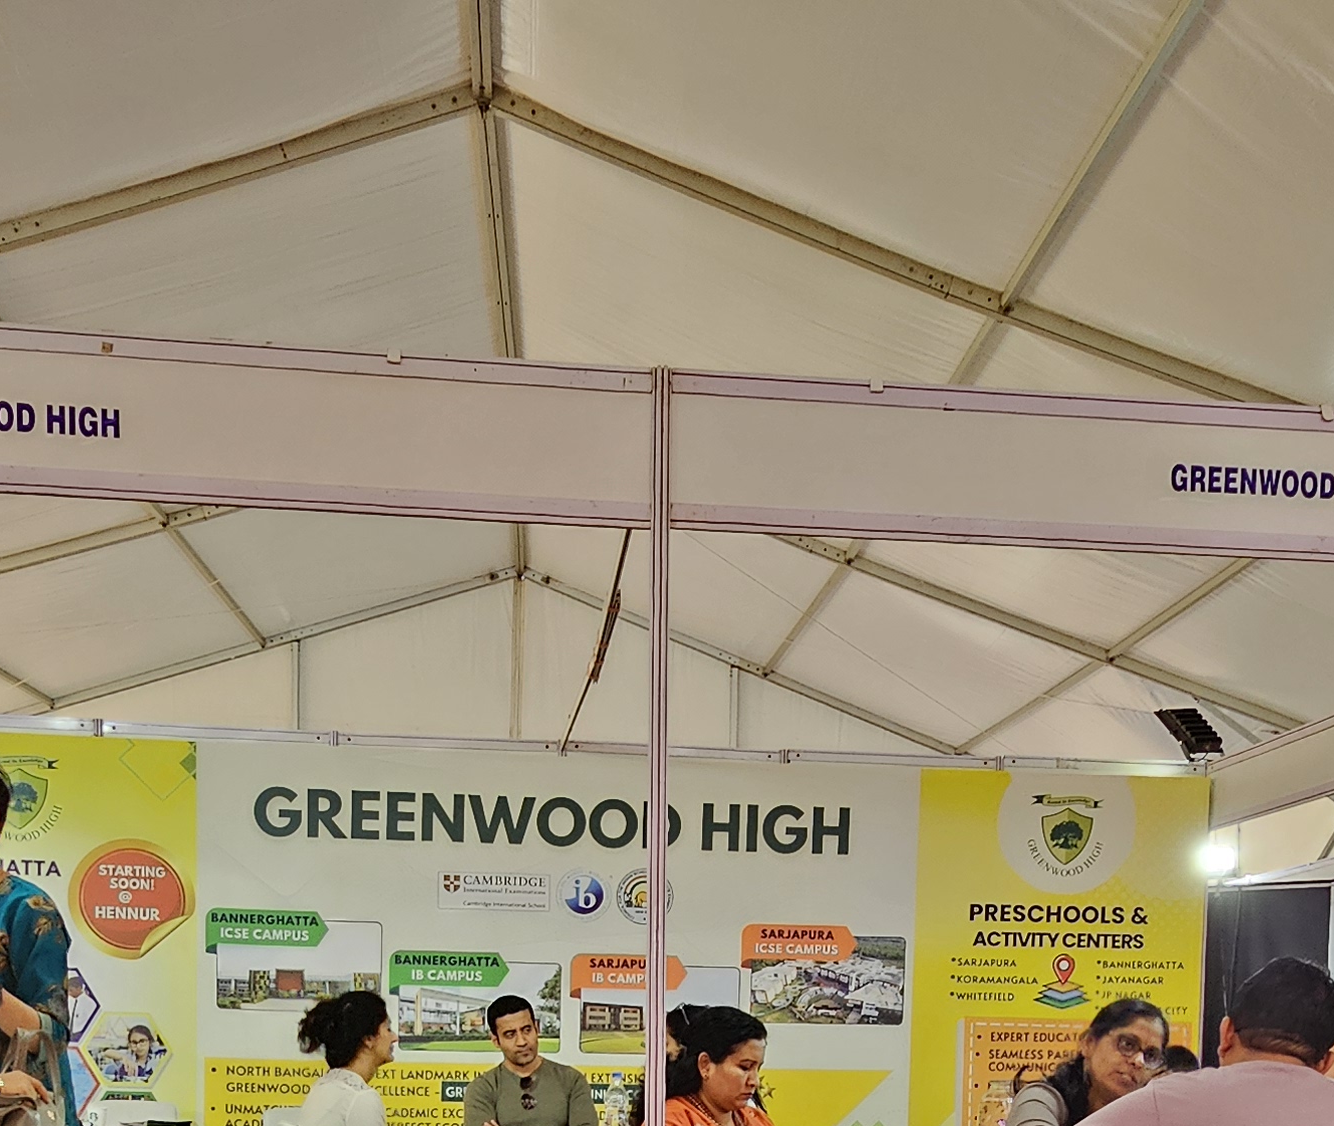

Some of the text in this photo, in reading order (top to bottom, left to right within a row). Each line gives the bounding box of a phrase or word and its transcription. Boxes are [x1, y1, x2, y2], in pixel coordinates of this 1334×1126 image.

[46, 404, 121, 438] HIGH
[701, 802, 851, 855] HIGH
[1027, 839, 1104, 877] GREENWOOD HIGH
[98, 864, 166, 878] STARTING
[109, 878, 155, 890] SOON!
[463, 874, 546, 887] CAMBRIDGE
[118, 891, 132, 904] @
[95, 906, 160, 921] HENNUR
[210, 912, 319, 927] BANNERGHATTA
[969, 903, 1148, 924] PRESCHOOLS &
[220, 927, 309, 941] ICSE CAMPUS
[760, 929, 835, 940] SARJAPURA
[972, 931, 1144, 949] ACTIVITY CENTERS
[755, 943, 838, 955] ICSE CAMPUS
[394, 954, 499, 968] BANNERGHATTA
[589, 959, 646, 969] SARJAPU
[957, 957, 1185, 970] SARJAPURA BANNERGHATTA
[411, 969, 483, 981] IB CAMPUS
[591, 972, 646, 984] IB CAMP
[956, 975, 1164, 985] KORAMANGALA JAYANAGAR
[956, 991, 1151, 1001] WHITEFIELD JP NAGAR
[1165, 1006, 1188, 1015] CITY
[990, 1032, 1080, 1043] EXPERT EDUCAT
[989, 1049, 1043, 1060] SEAMLESS
[226, 1066, 270, 1076] NORTH
[376, 1069, 396, 1079] EXT
[401, 1070, 469, 1080] LANDMARK
[226, 1082, 311, 1094] GREENWOOD
[371, 1085, 430, 1097] CELLENCE
[386, 1108, 438, 1118] CADEMIC
